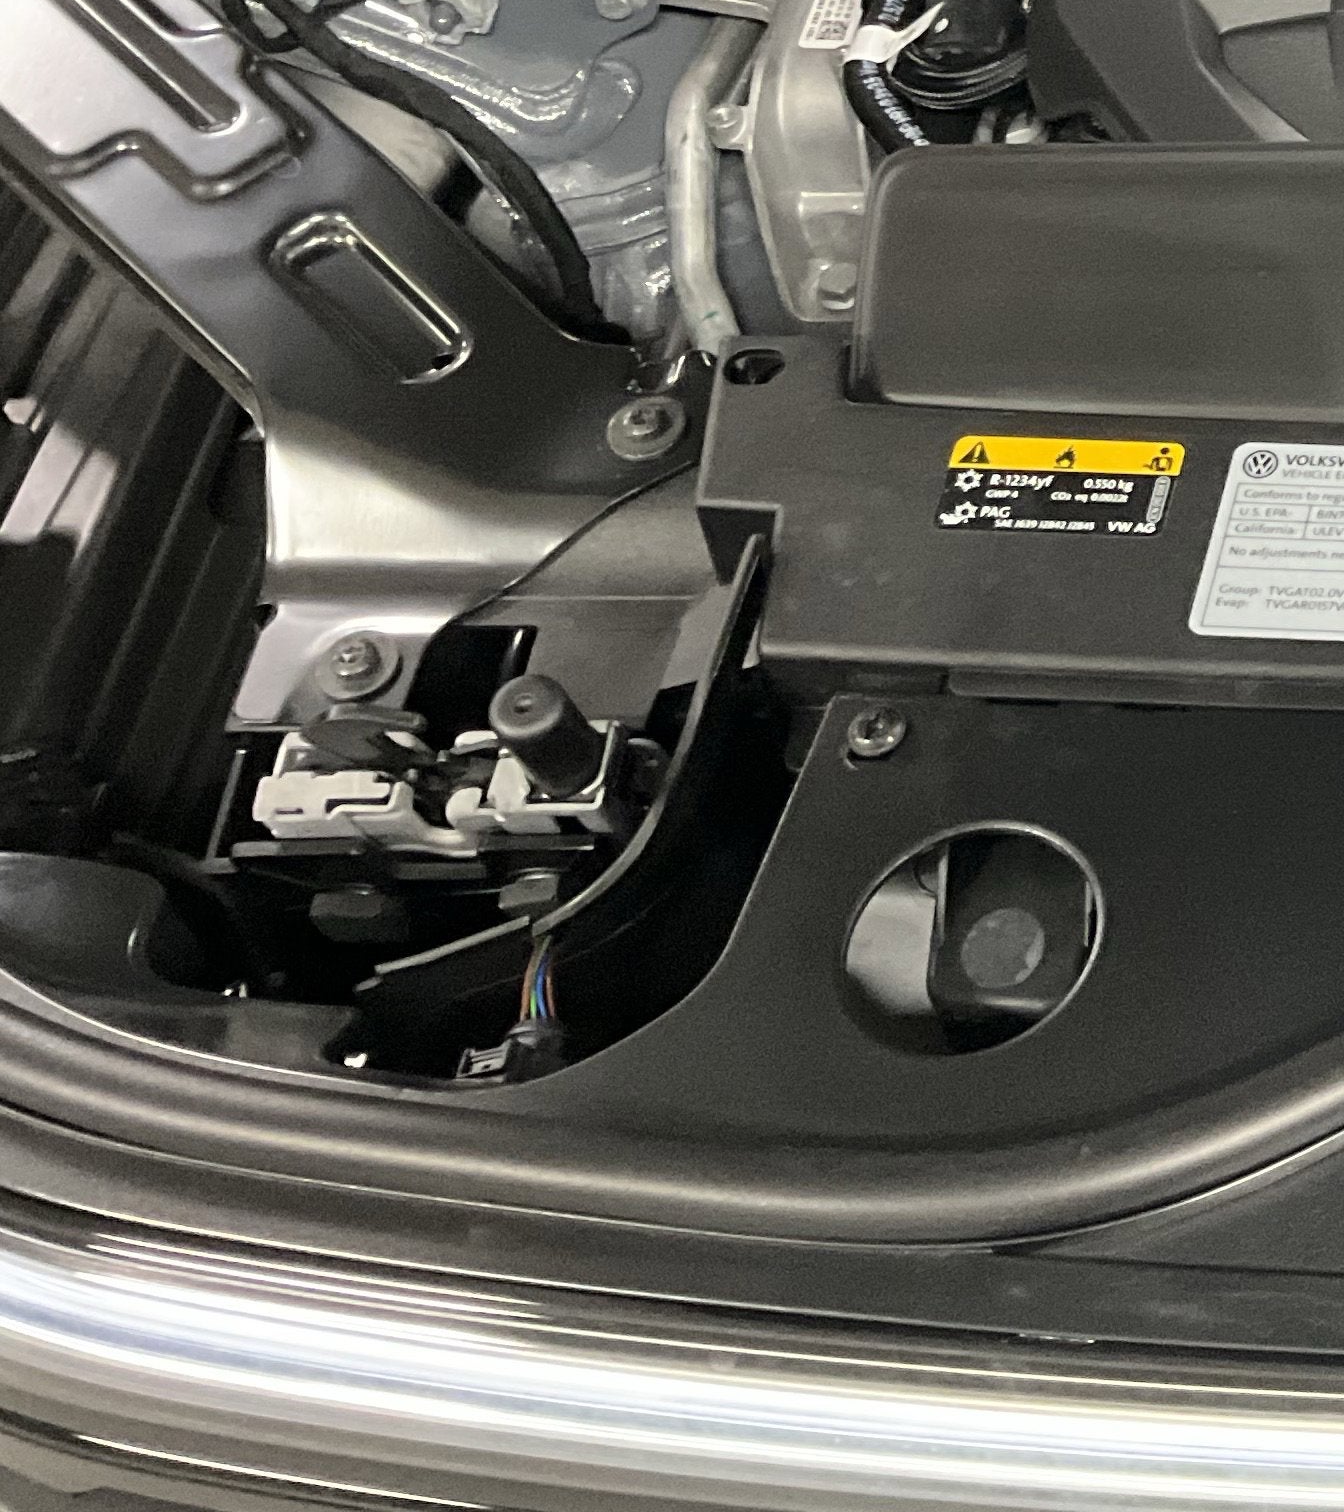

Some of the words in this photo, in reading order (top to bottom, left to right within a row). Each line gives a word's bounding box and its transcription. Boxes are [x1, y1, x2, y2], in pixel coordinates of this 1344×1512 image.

[1282, 469, 1333, 480] VEHICLE
[990, 474, 1055, 492] R-1234yf
[1083, 478, 1116, 490] 0.550
[1118, 479, 1134, 493] kg
[1243, 489, 1303, 501] Conforms
[1306, 491, 1319, 501] to
[979, 506, 1011, 518] PAG
[1107, 521, 1132, 533] VW
[1133, 522, 1157, 534] AG
[1228, 546, 1247, 556] No
[1249, 546, 1327, 560] adjustments
